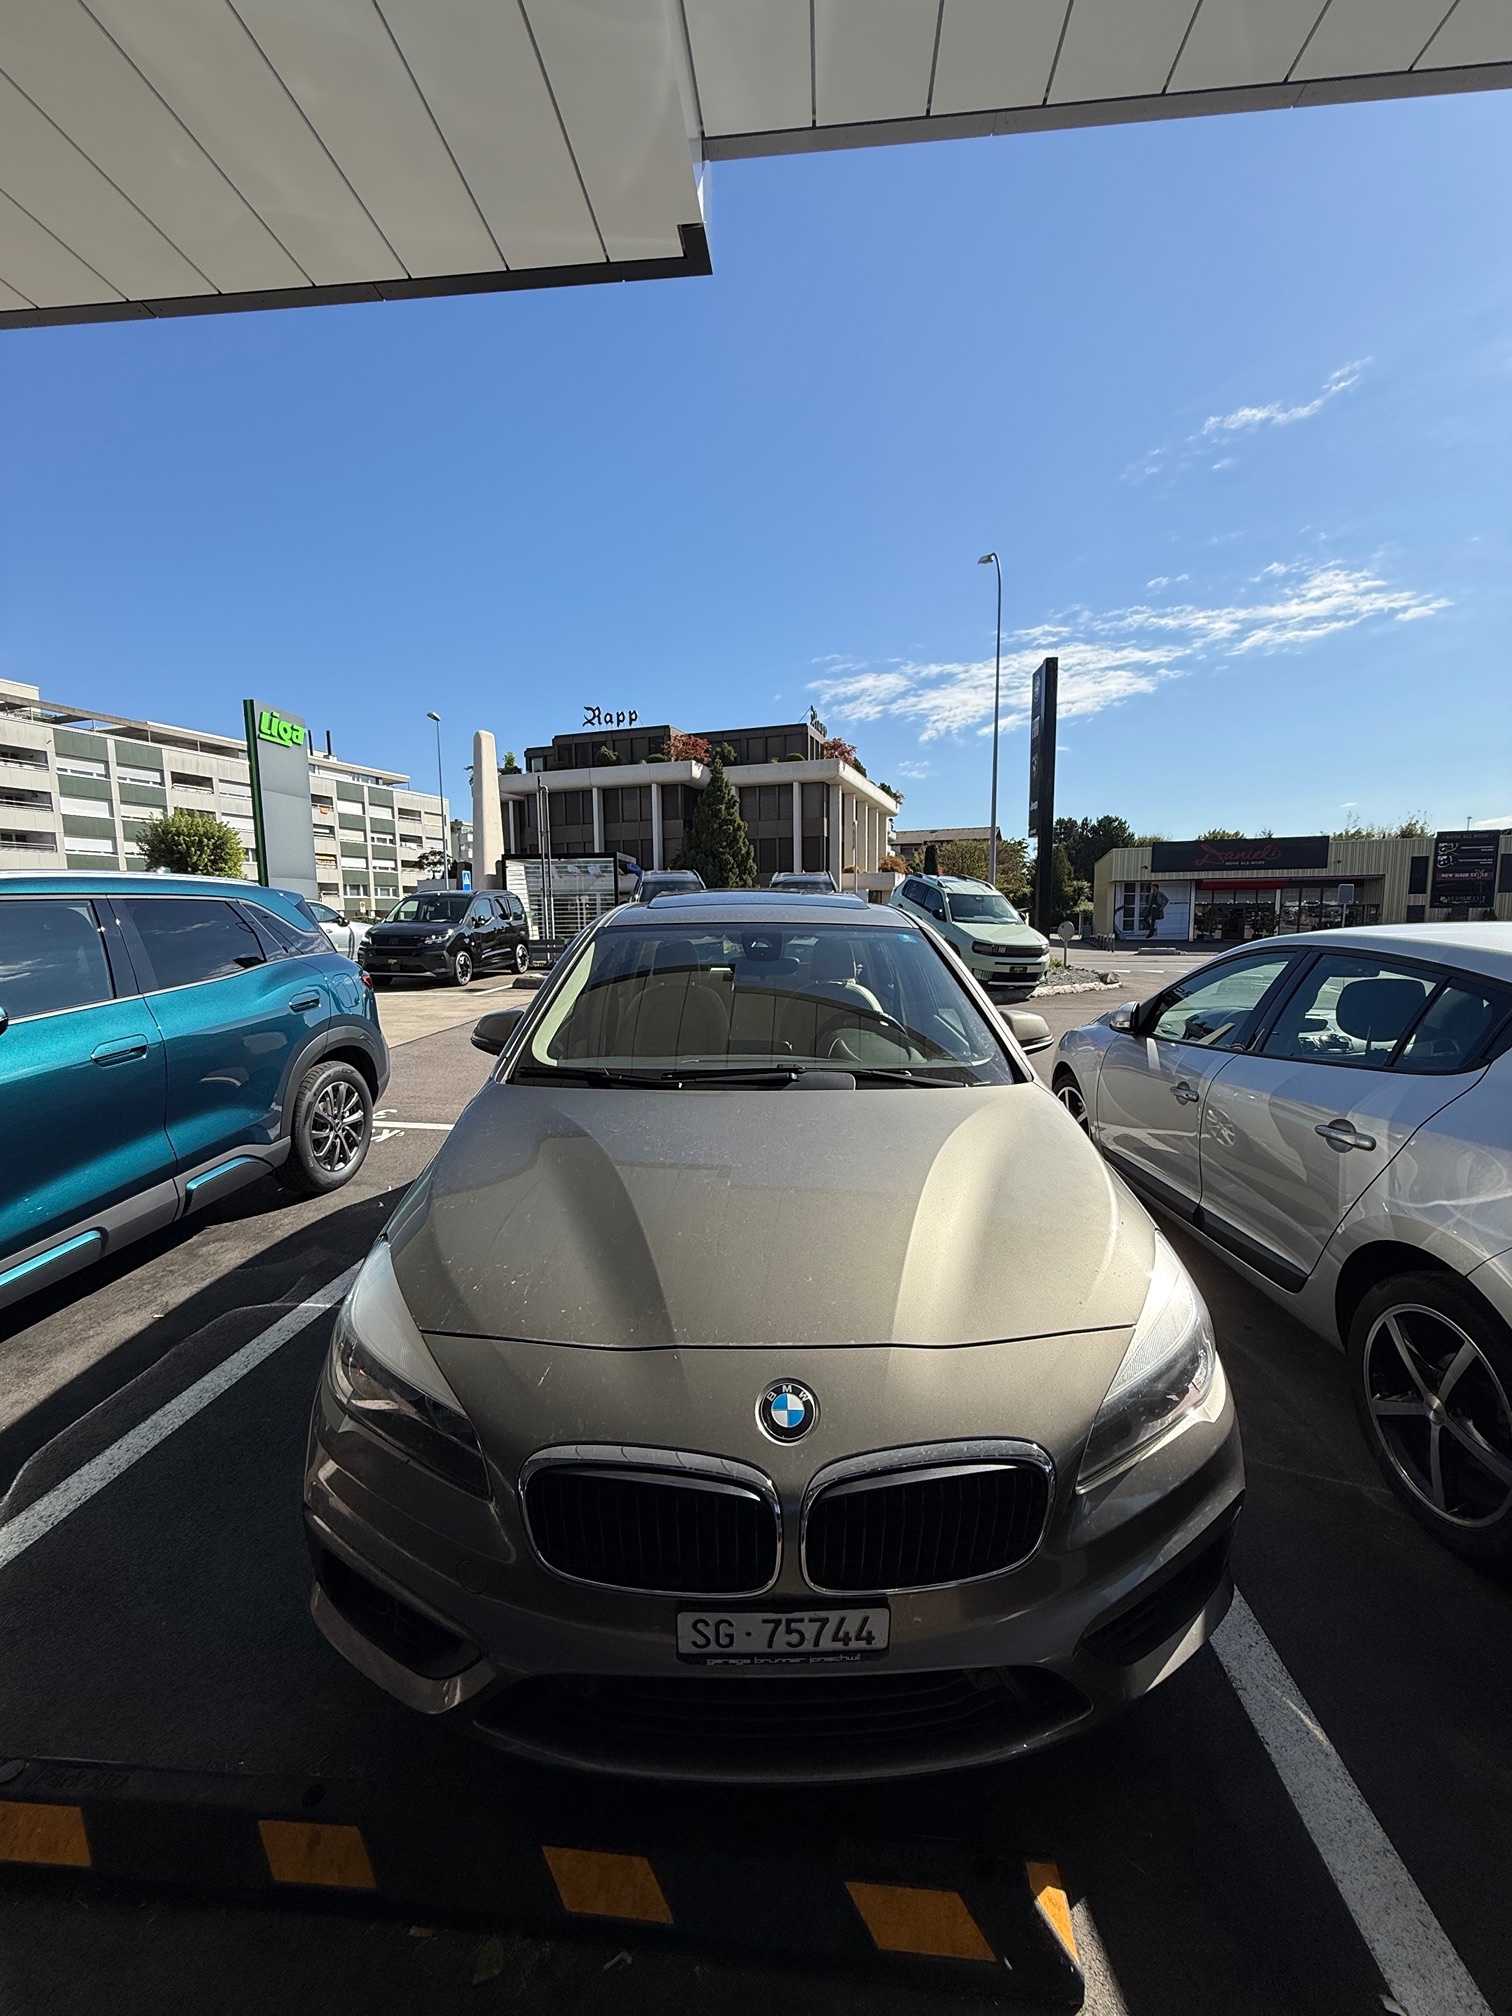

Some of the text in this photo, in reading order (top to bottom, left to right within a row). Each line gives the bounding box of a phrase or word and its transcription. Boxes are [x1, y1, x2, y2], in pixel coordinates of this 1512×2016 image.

[582, 705, 638, 728] Rapp
[258, 711, 305, 748] Liga
[766, 1384, 810, 1402] BMW
[762, 1616, 875, 1648] 75744
[754, 1656, 806, 1664] brunner
